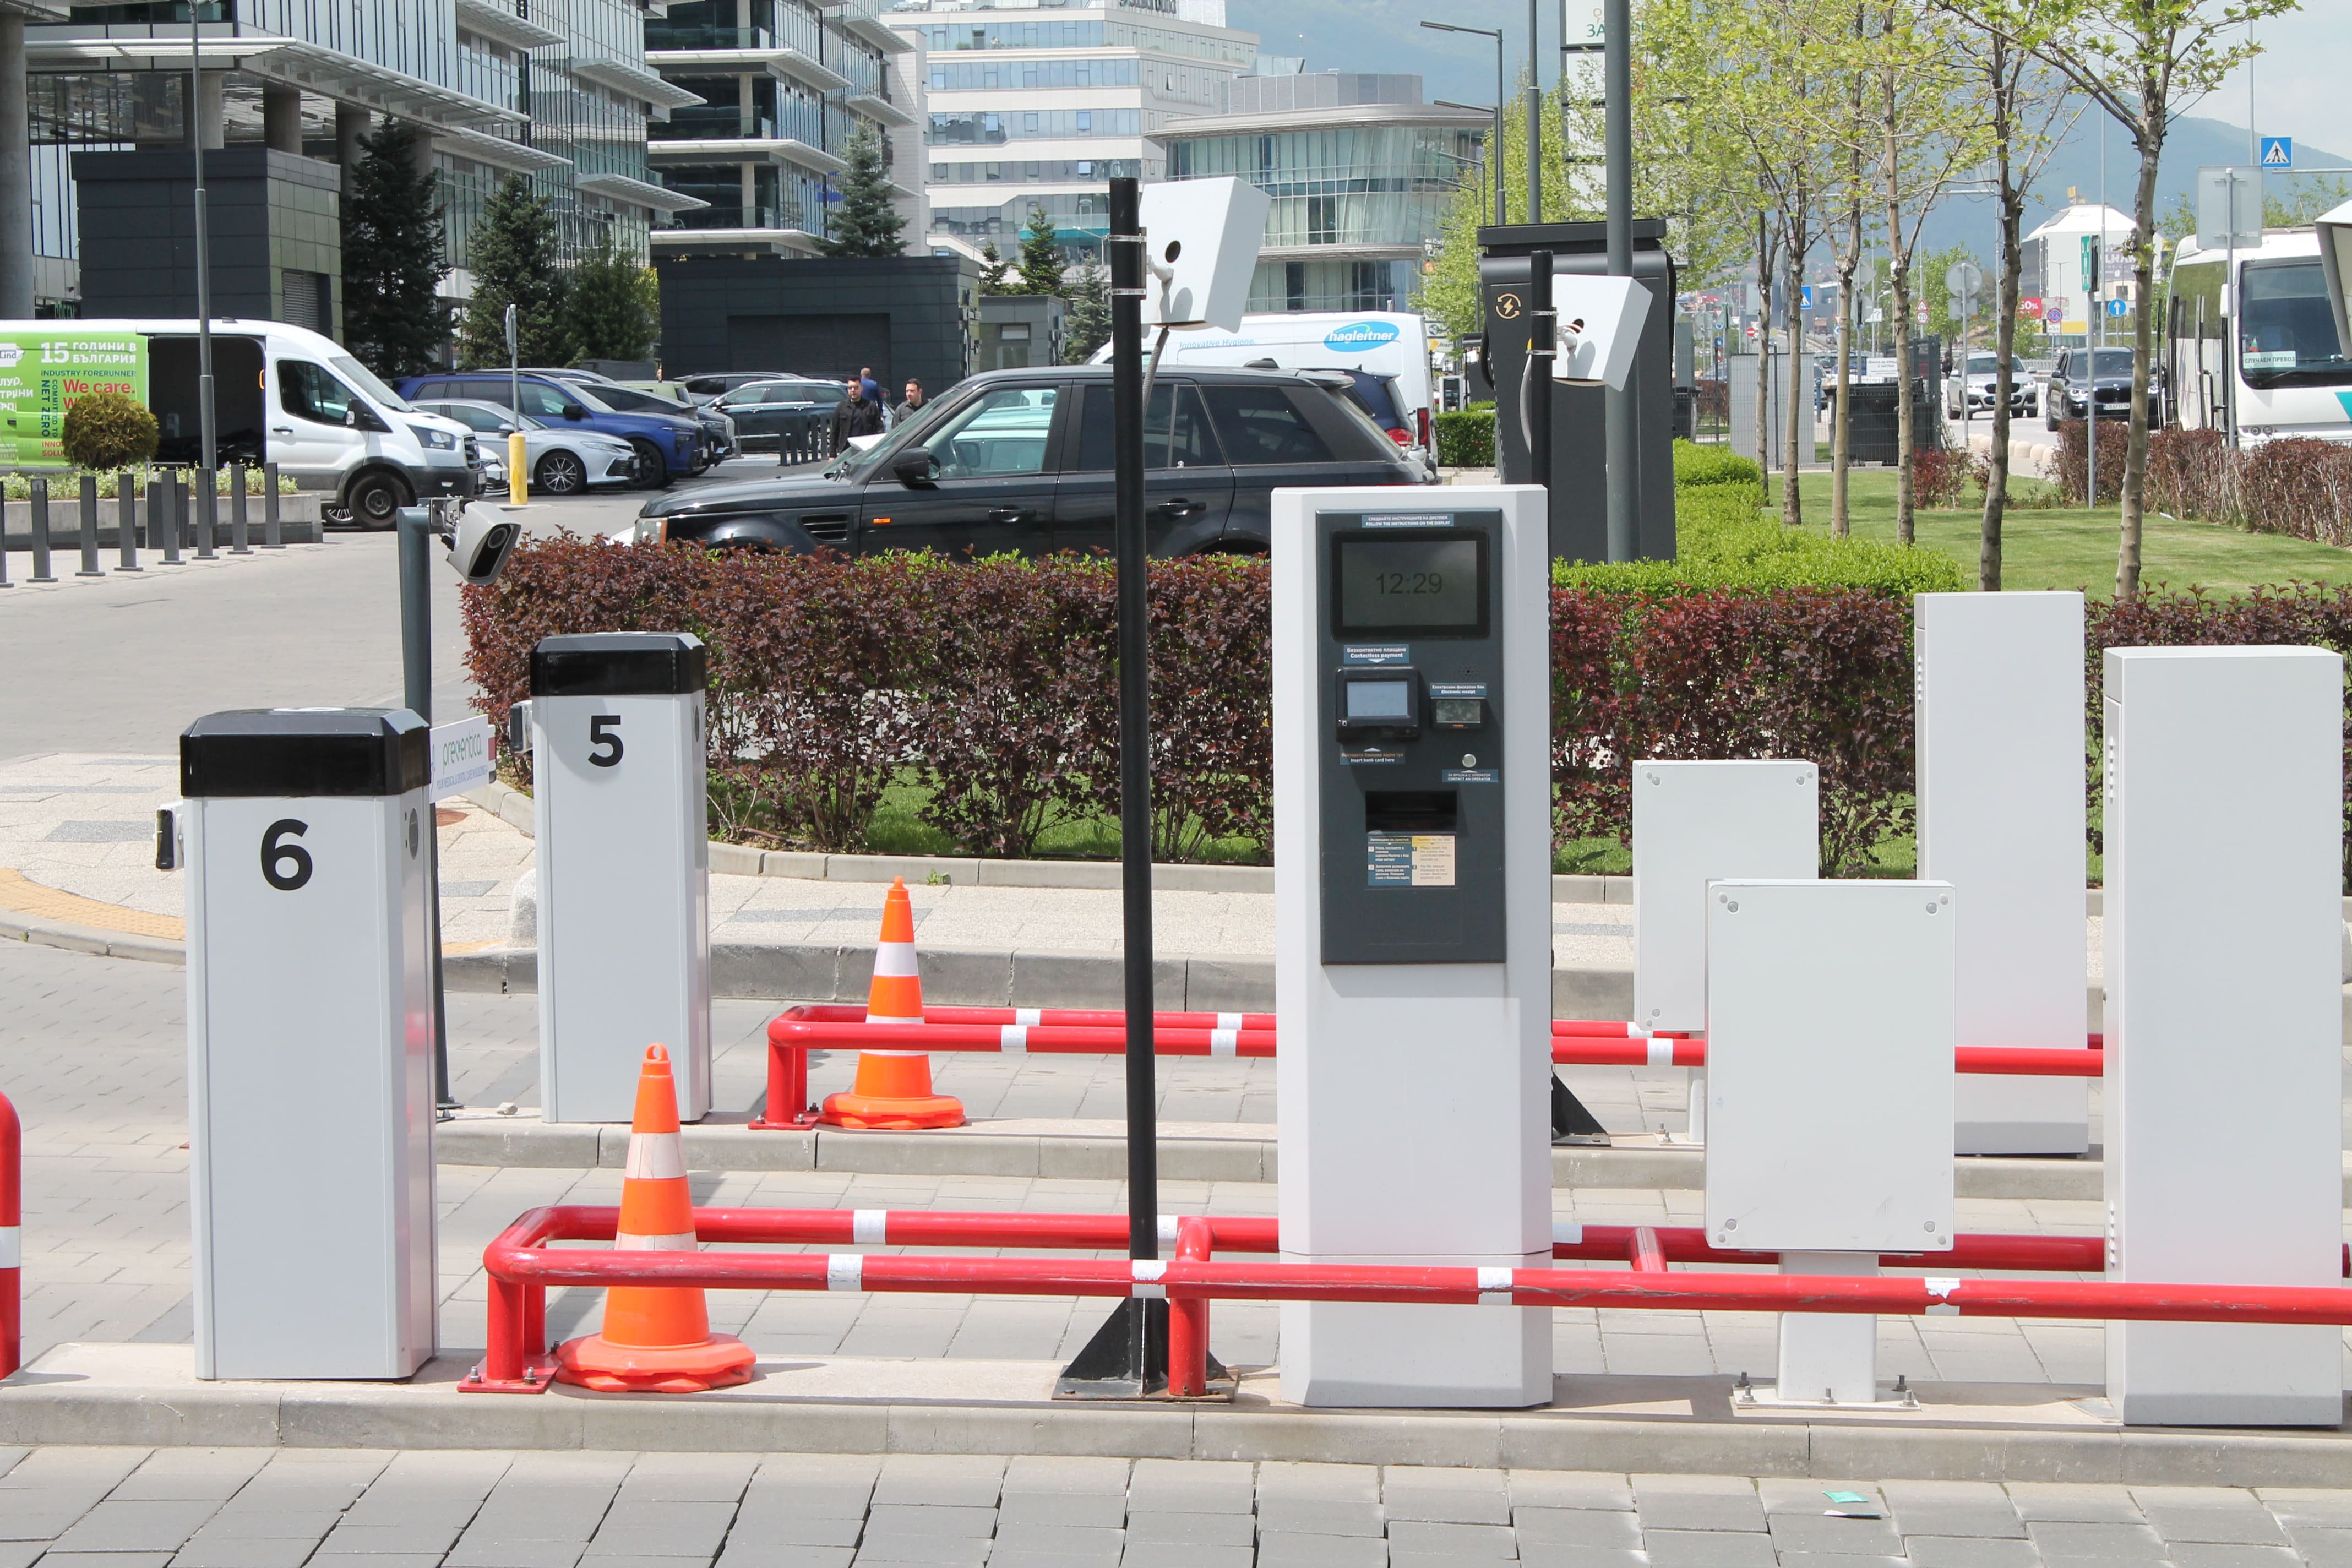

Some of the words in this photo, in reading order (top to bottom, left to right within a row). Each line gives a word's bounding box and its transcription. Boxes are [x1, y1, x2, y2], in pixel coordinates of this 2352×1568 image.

[1222, 339, 1256, 347] Hygiene.
[1329, 330, 1395, 344] hagleitner
[41, 342, 69, 363] 15
[73, 342, 125, 352] ГОДИНИ
[129, 342, 137, 351] В
[73, 354, 137, 363] БЪЛГАРИЯ
[63, 379, 89, 393] We
[93, 383, 135, 394] care.
[52, 428, 58, 437] TO
[1376, 572, 1442, 594] 12:29
[587, 715, 624, 767] 5
[260, 818, 313, 891] 6
